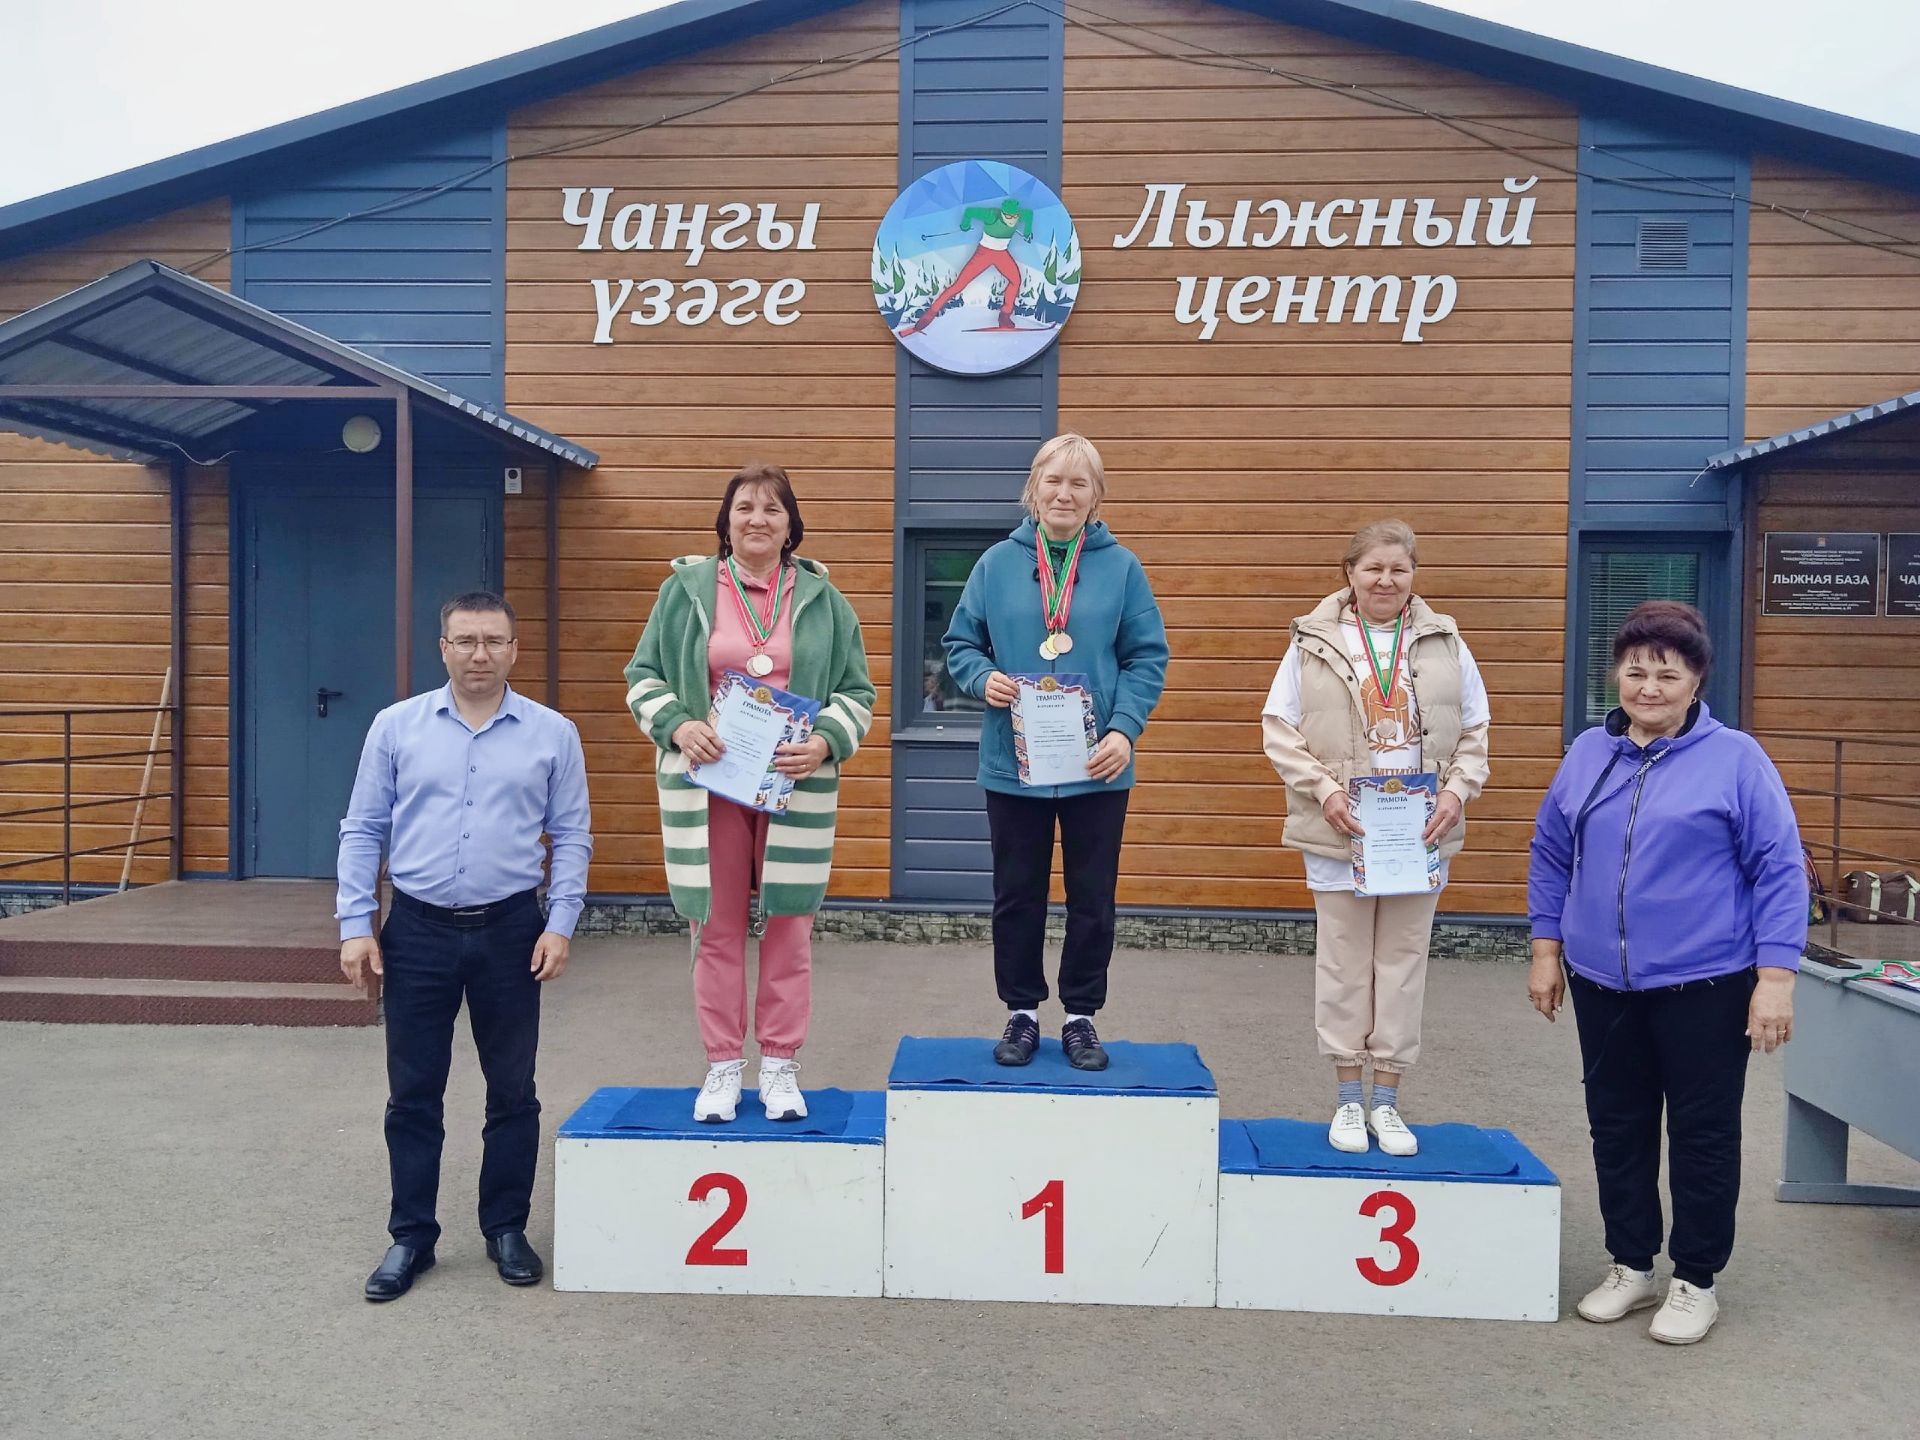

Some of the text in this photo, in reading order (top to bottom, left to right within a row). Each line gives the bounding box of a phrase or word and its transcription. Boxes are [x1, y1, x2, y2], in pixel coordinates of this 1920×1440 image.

[561, 187, 821, 266] Чаңгы
[1112, 175, 1539, 248] Лыжный
[590, 278, 806, 343] үзәге
[1174, 274, 1458, 343] центр
[1772, 574, 1870, 585] ЛЫЖНАЯ БАЗА
[742, 700, 772, 717] ГРАМОТА
[1036, 694, 1065, 702] ГРАМОТА
[1377, 796, 1408, 804] ГРАМОТА
[685, 1172, 748, 1266] 2
[1022, 1179, 1065, 1274] 1
[1356, 1190, 1420, 1286] 3
